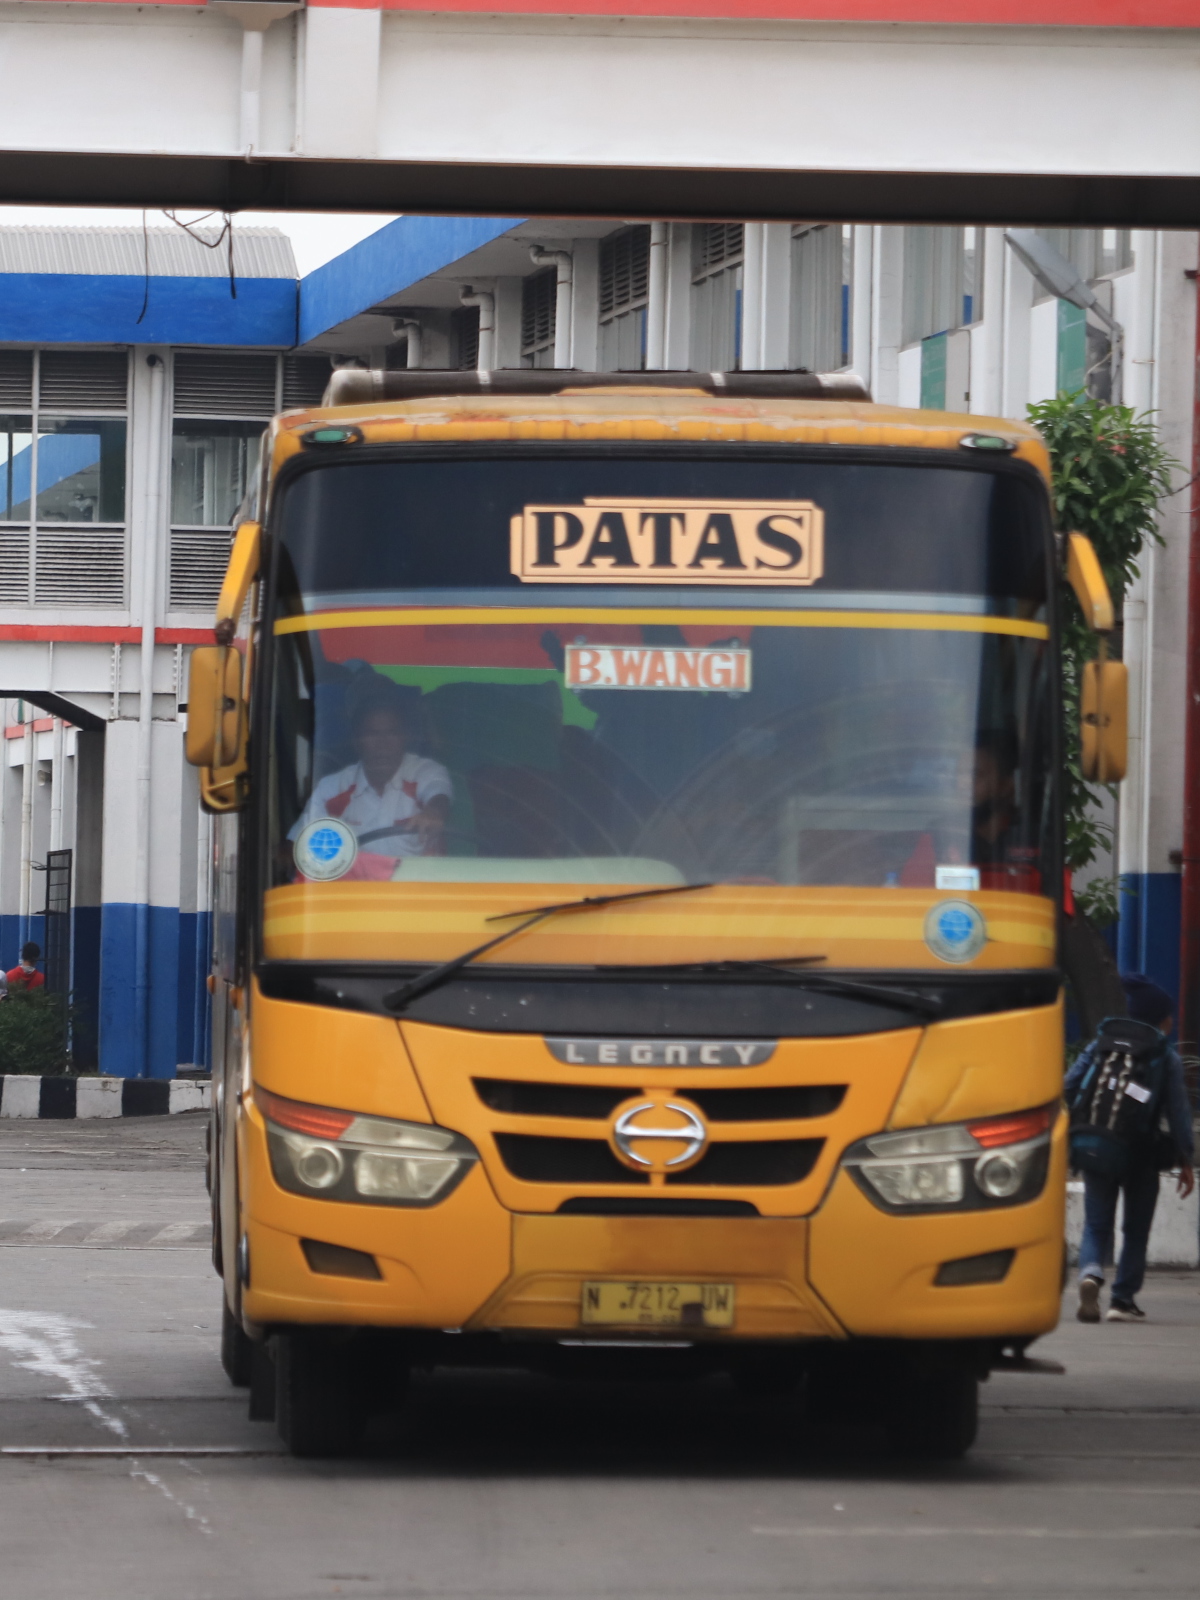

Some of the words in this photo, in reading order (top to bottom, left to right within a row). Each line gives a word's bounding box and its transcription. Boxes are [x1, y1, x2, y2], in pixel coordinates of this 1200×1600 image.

[530, 511, 804, 571] PATAS
[567, 649, 748, 689] B.WANGI
[566, 1043, 756, 1065] LEGACY
[587, 1287, 600, 1310] N
